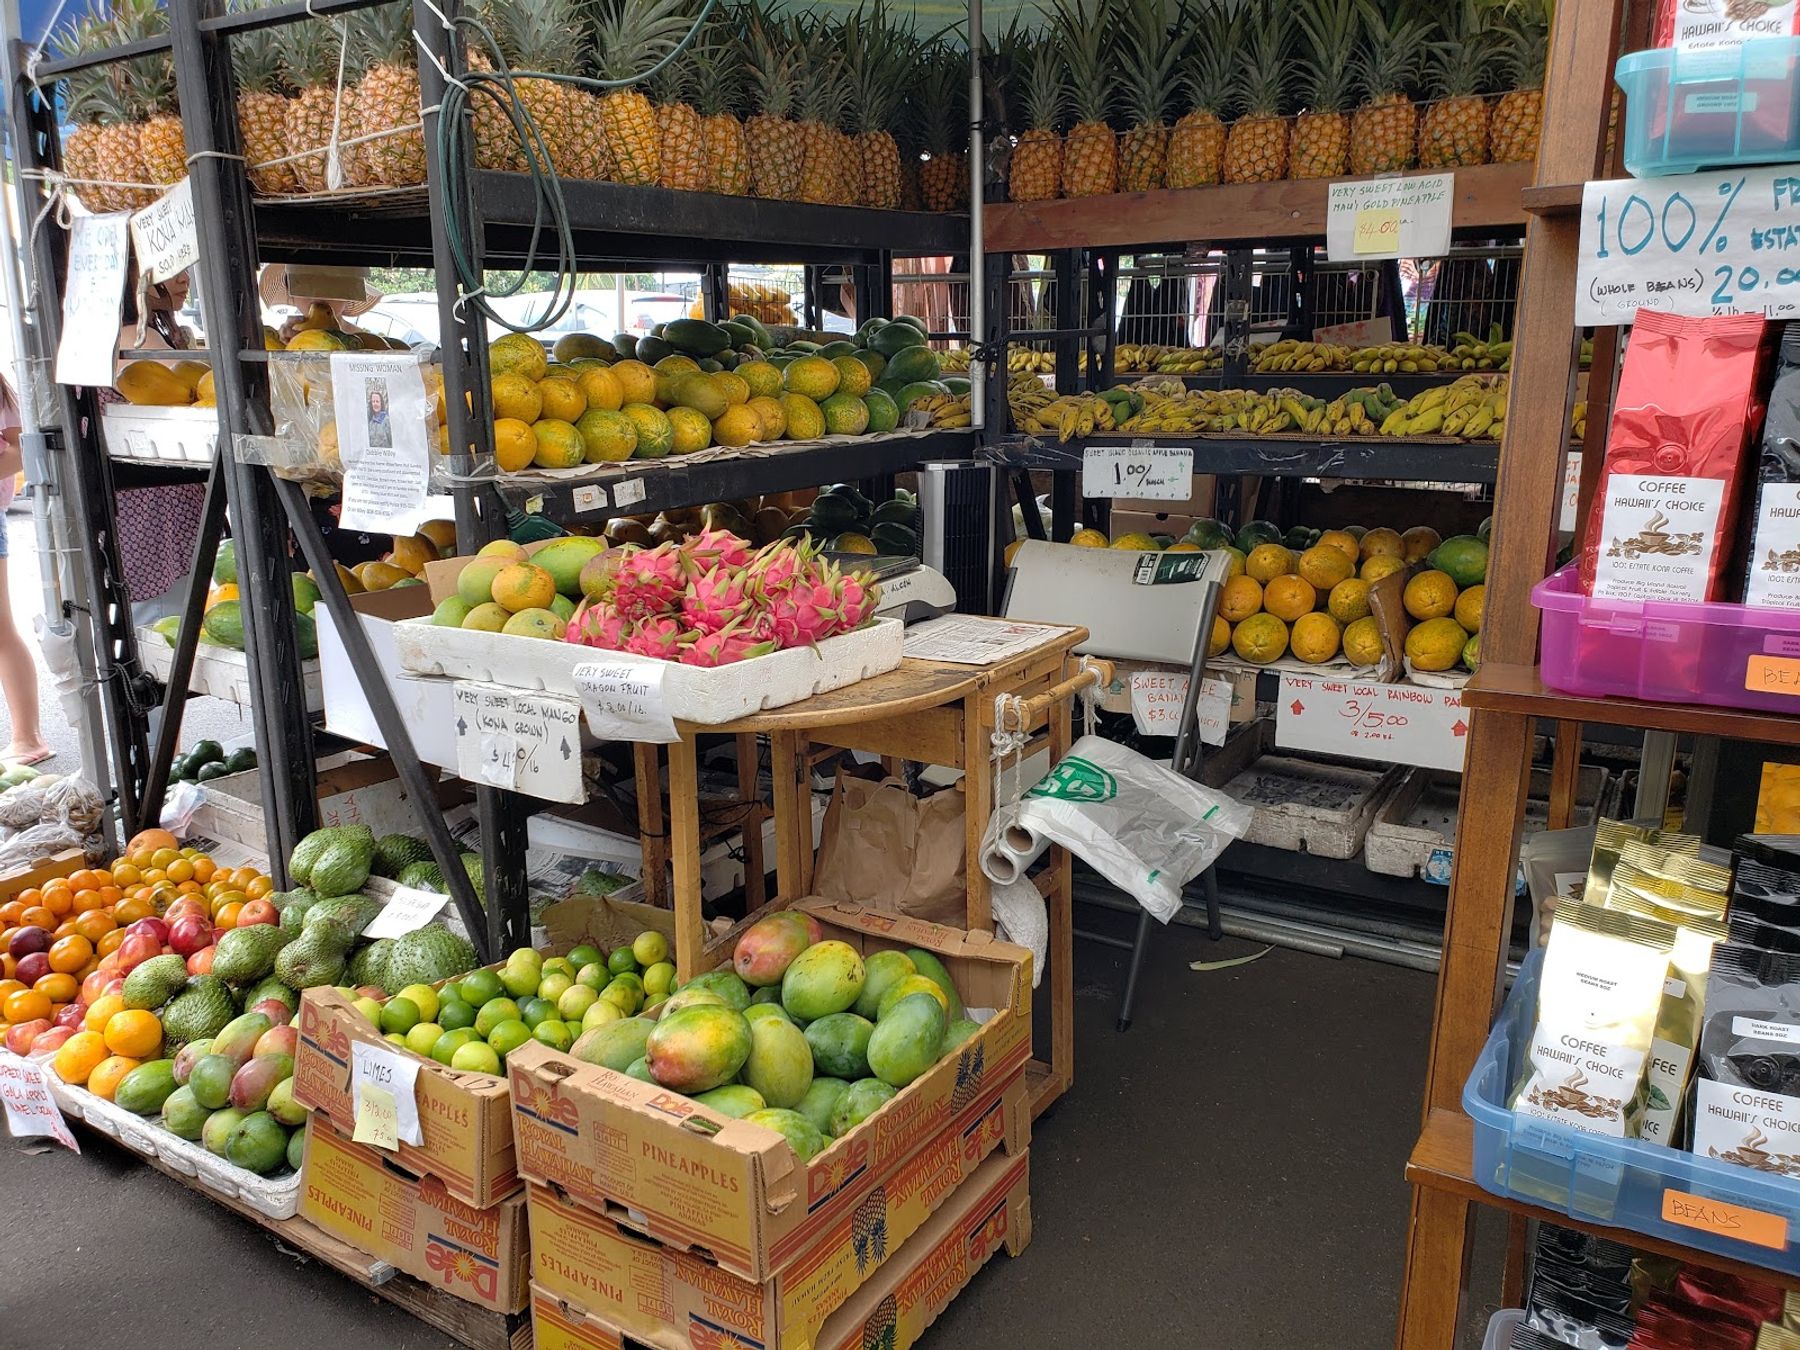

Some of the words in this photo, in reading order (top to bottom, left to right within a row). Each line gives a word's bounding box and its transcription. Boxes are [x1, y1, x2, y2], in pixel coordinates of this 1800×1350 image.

[1681, 20, 1732, 40] HAWAII'S
[1739, 20, 1782, 34] CHOICE
[1332, 187, 1355, 197] VERY
[1359, 183, 1396, 195] SWEET
[1397, 182, 1416, 192] LOW
[1418, 178, 1443, 190] ACID
[1364, 200, 1388, 210] GOLD
[1391, 190, 1446, 207] PINEAPPLE
[1596, 176, 1745, 258] 100%
[349, 363, 374, 372] MISSING
[376, 365, 402, 373] WOMAN
[1638, 480, 1687, 494] COFFEE
[1614, 497, 1661, 510] HAWAII'S
[1665, 500, 1705, 512] CHOICE
[1629, 563, 1650, 571] ESTATE
[1652, 565, 1670, 573] KONA
[582, 684, 616, 694] DRAGON
[619, 682, 650, 696] FRUIT
[600, 668, 633, 679] SWEET
[1133, 677, 1175, 690] SWEET
[1182, 679, 1217, 696] ALE
[1285, 677, 1312, 689] VERY
[1321, 683, 1348, 693] SWEET
[1354, 687, 1379, 697] LOCAL
[1387, 689, 1433, 704] RAINBOW
[455, 690, 479, 705] VERY
[484, 696, 510, 709] SWEET
[541, 707, 576, 724] MANGO
[1338, 700, 1409, 728] 3/5.00
[302, 1001, 350, 1059] Dole
[1560, 1034, 1608, 1058] COFFEE
[363, 1060, 393, 1083] LIMES
[1536, 1045, 1581, 1066] HAWAII'S
[1586, 1059, 1624, 1080] CHOICE
[416, 1090, 468, 1128] EAPPLES
[512, 1069, 579, 1129] Dole
[649, 1093, 694, 1116] Dole
[1733, 1092, 1783, 1112] COFFEE
[517, 1112, 566, 1153] ROYAL
[964, 1106, 1004, 1160] Dole
[1708, 1104, 1757, 1123] HAWAII'S
[1763, 1117, 1800, 1133] CHOICE
[521, 1136, 594, 1185] HAWAIIAN
[642, 1140, 738, 1193] PINEAPPLES
[808, 1139, 869, 1207] Dole
[308, 1184, 373, 1232] PINEAPPLES
[1671, 1199, 1744, 1230] BEANS
[444, 1216, 499, 1259] ROYAL
[970, 1205, 1008, 1262] Dole
[425, 1242, 497, 1302] Dole
[540, 1252, 624, 1303] PINEAPPLES
[675, 1263, 764, 1317] HAWAIIAN
[704, 1296, 764, 1341] ROYAL
